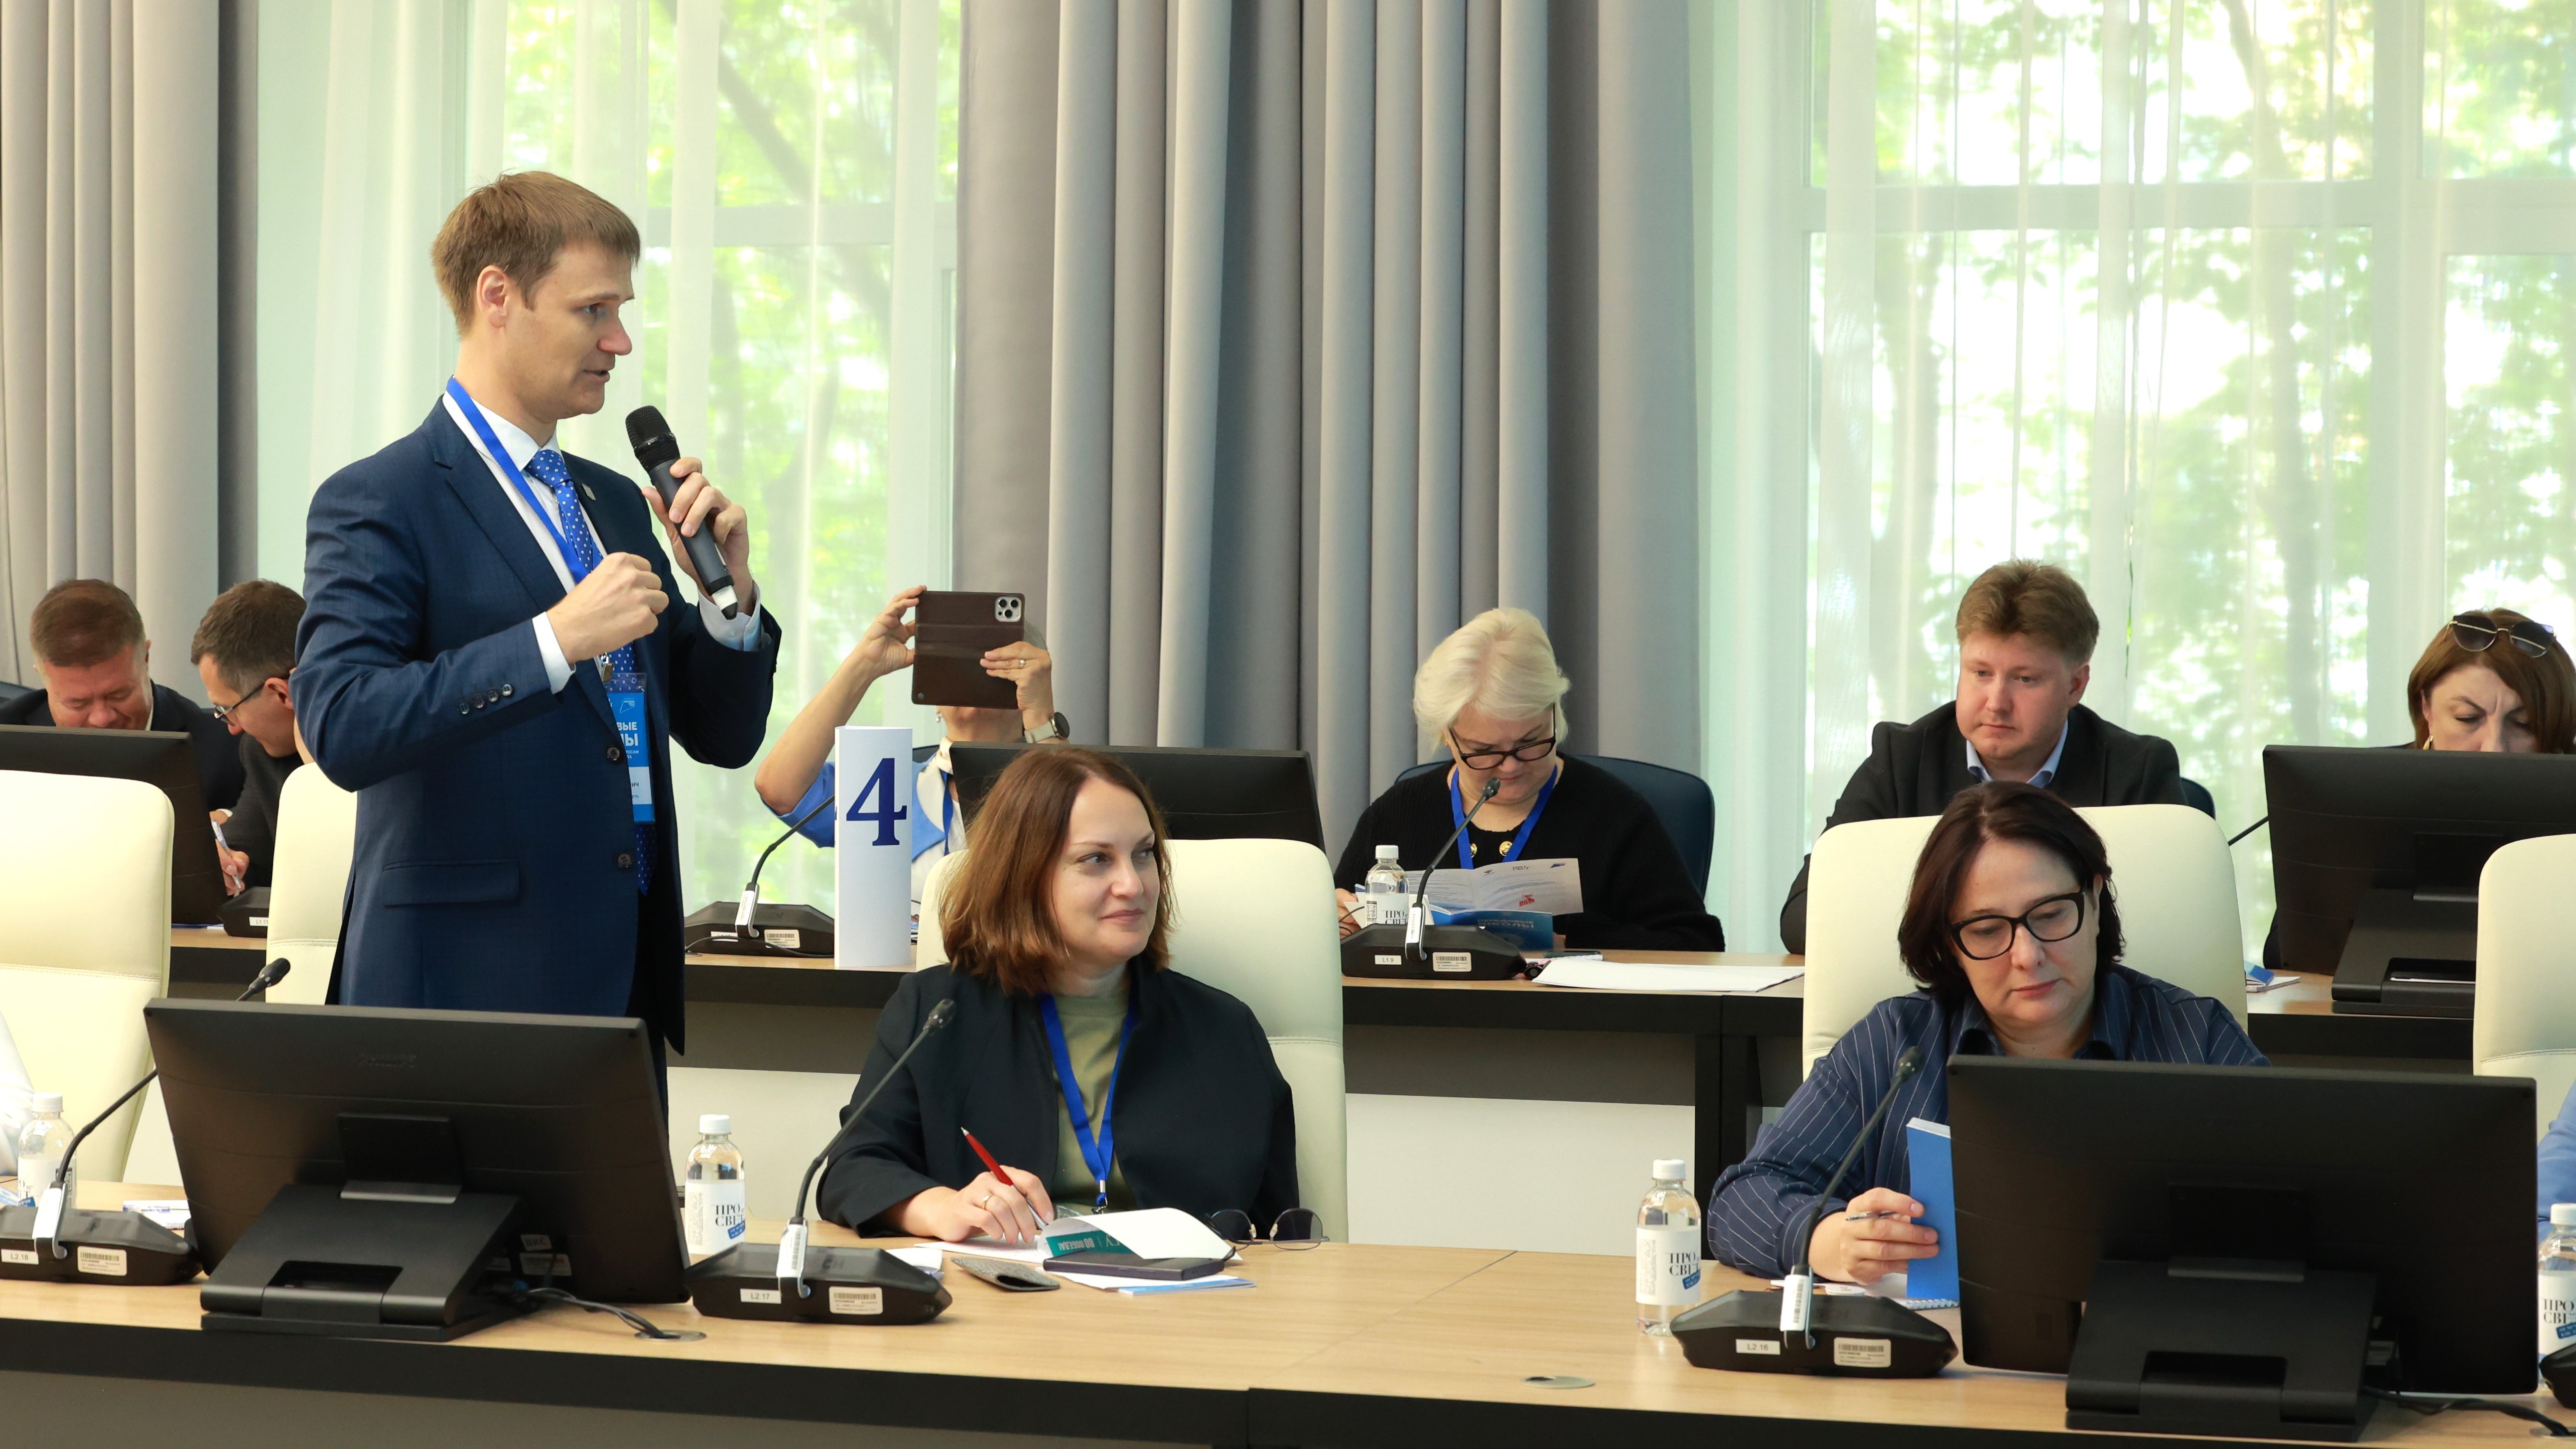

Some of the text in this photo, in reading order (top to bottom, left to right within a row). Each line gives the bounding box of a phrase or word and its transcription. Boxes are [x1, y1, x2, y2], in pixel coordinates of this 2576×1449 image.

[846, 758, 907, 846] 4
[716, 1203, 740, 1215] ПРО
[1084, 1237, 1095, 1248] 80
[1670, 1252, 1696, 1264] ПРО
[2544, 1299, 2575, 1312] ПРО
